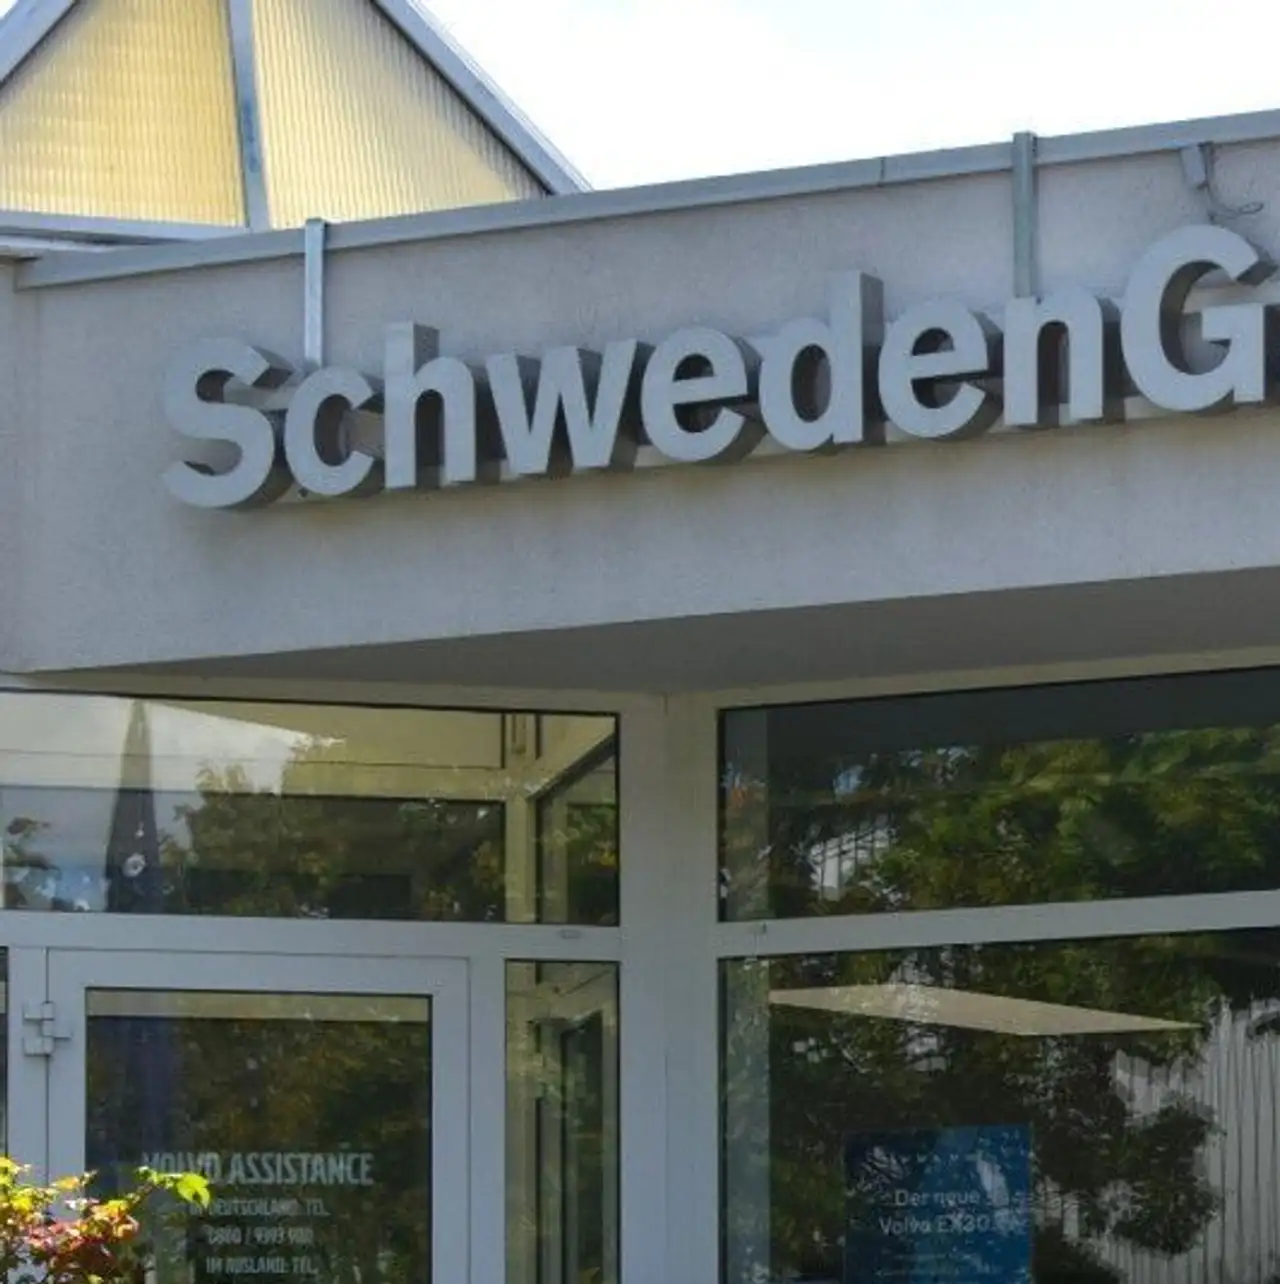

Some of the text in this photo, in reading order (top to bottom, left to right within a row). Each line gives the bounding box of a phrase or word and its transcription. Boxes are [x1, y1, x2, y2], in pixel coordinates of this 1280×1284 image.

[228, 1151, 374, 1186] ASSISTANCE
[894, 1188, 929, 1207] Der
[878, 1214, 932, 1236] Volvo
